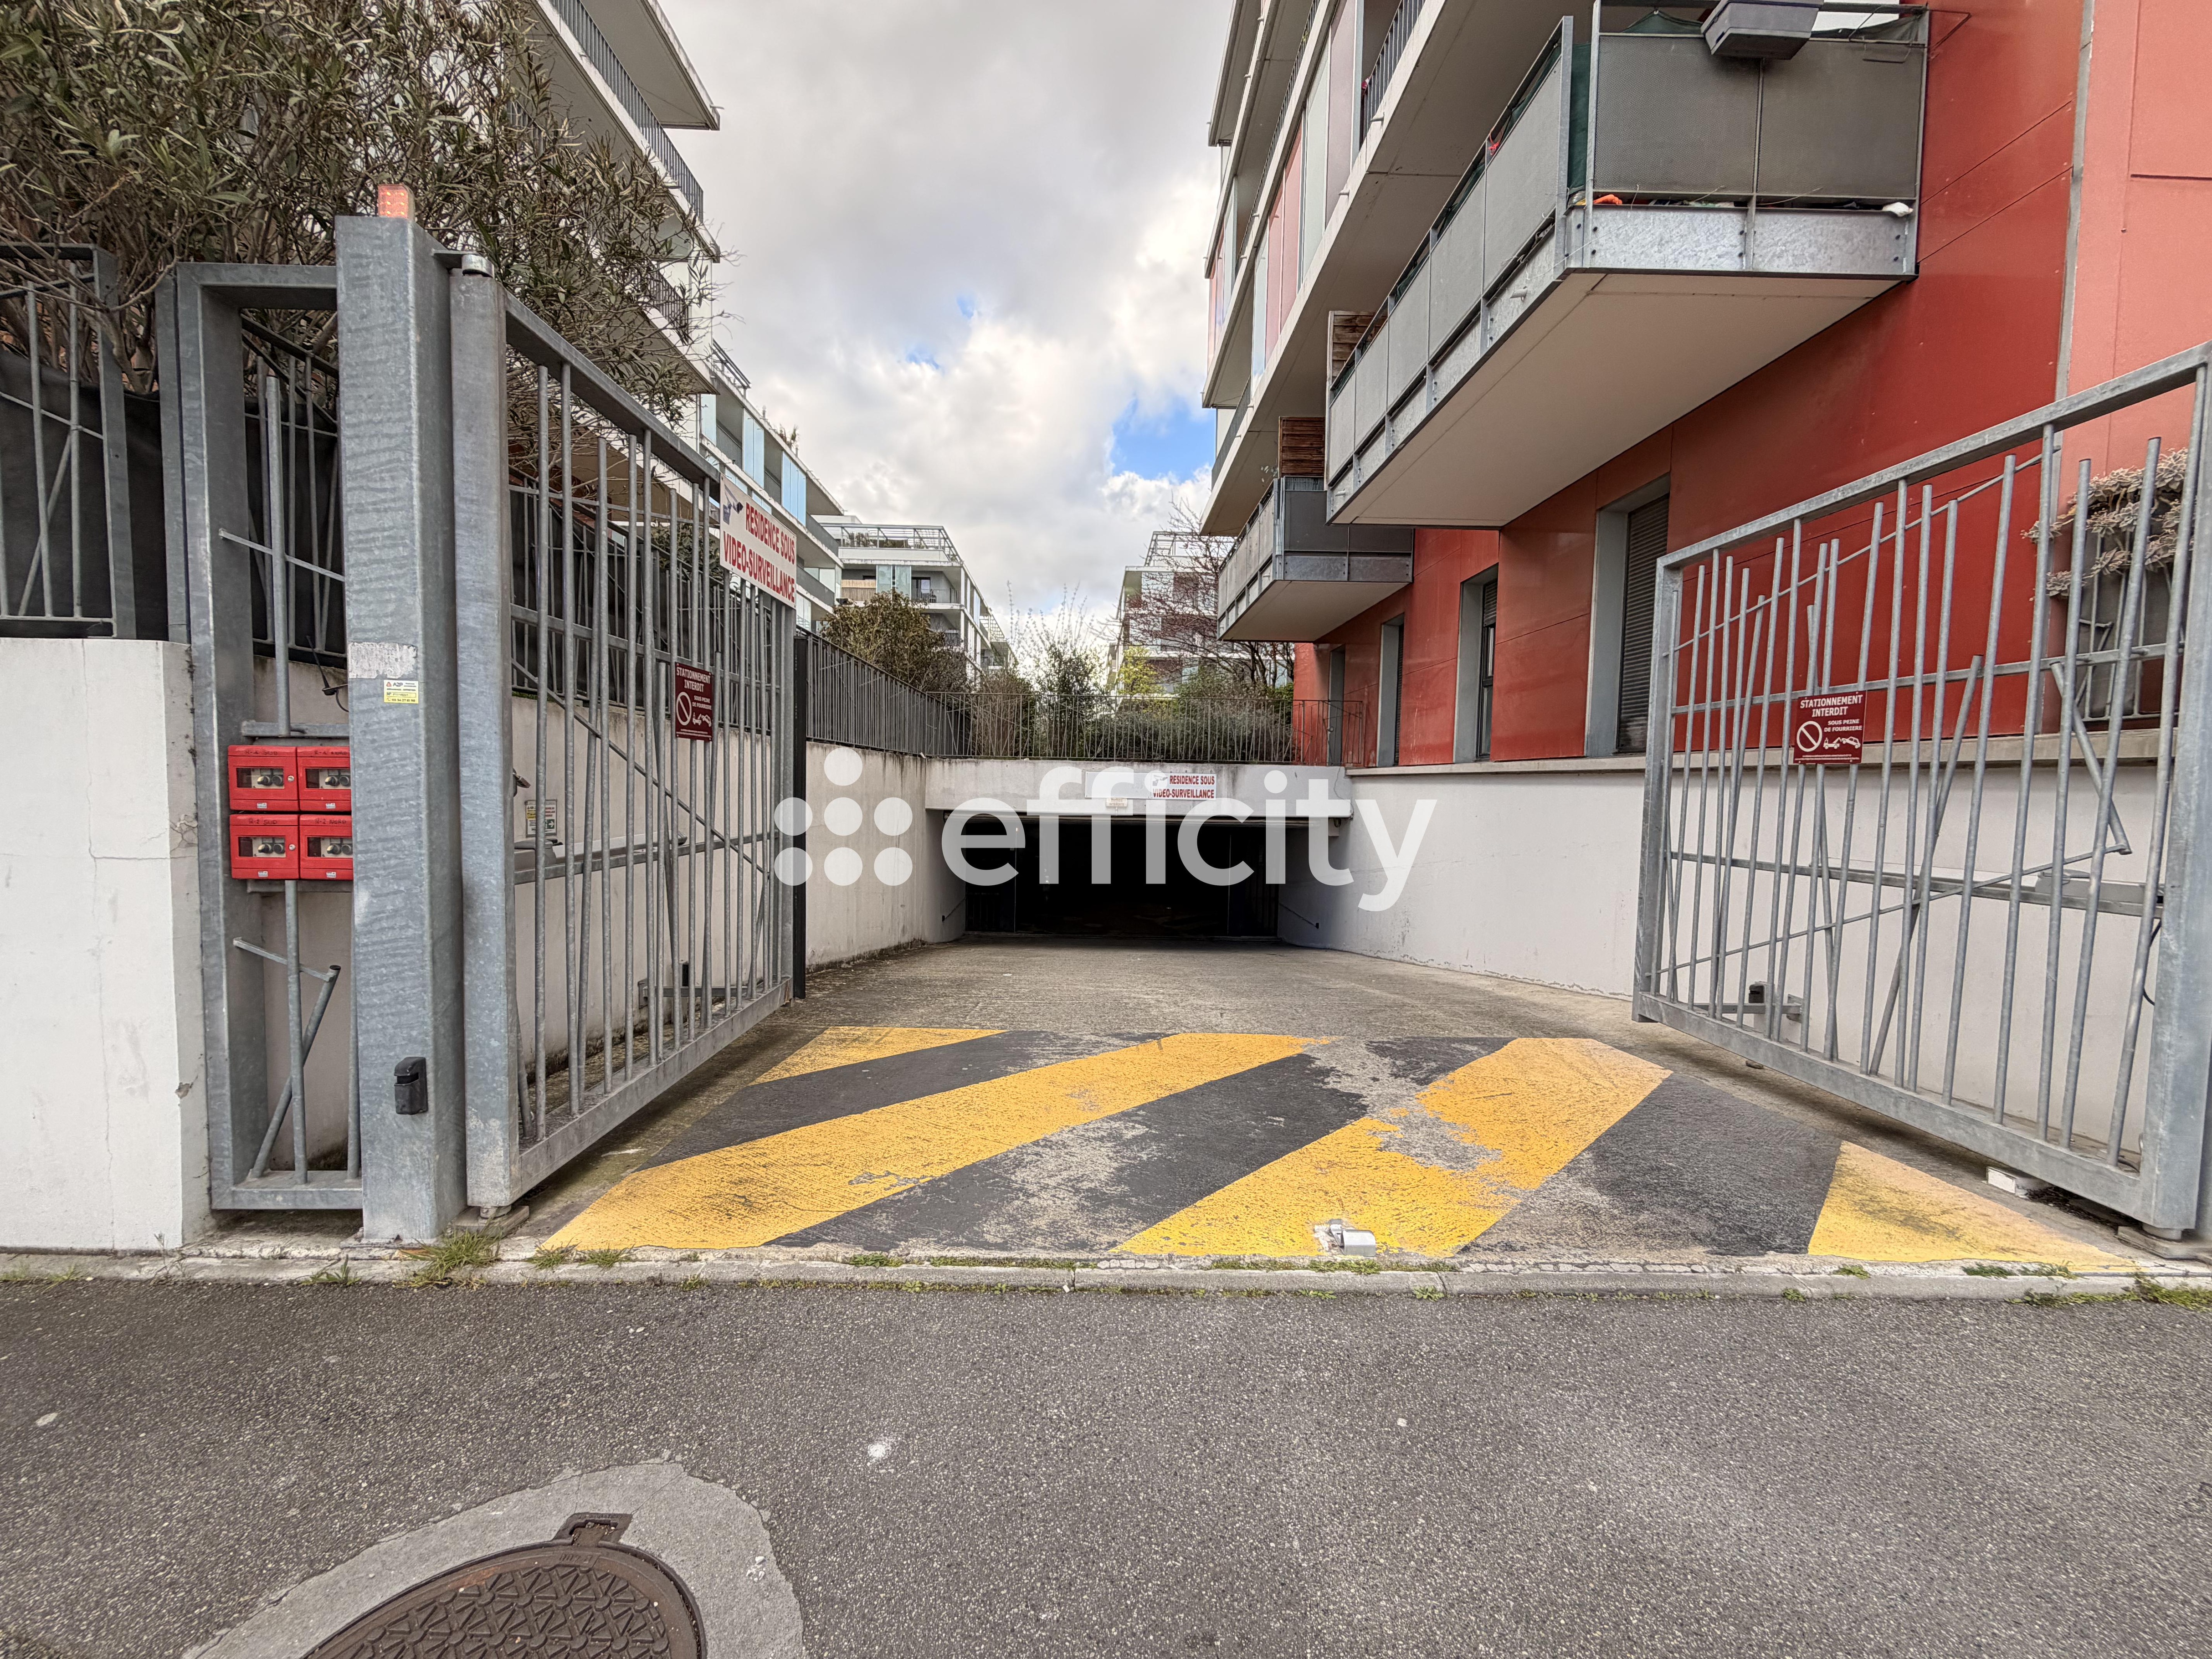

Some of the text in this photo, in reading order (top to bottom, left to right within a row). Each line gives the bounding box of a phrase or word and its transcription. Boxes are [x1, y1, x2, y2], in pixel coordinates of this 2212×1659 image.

[746, 502, 795, 565] RESIDENCE SOUS
[723, 530, 795, 603] VIDEO-SURVEILLANCE
[676, 667, 711, 684] STATIONNEMENT
[684, 679, 704, 693] INTERDIT
[1800, 694, 1863, 709] STATIONNEMENT
[1812, 706, 1848, 718] INTERDIT
[1169, 775, 1215, 785] RESIDENCE SOUS
[1153, 788, 1215, 799] VIDEO-SURVEILLANCE
